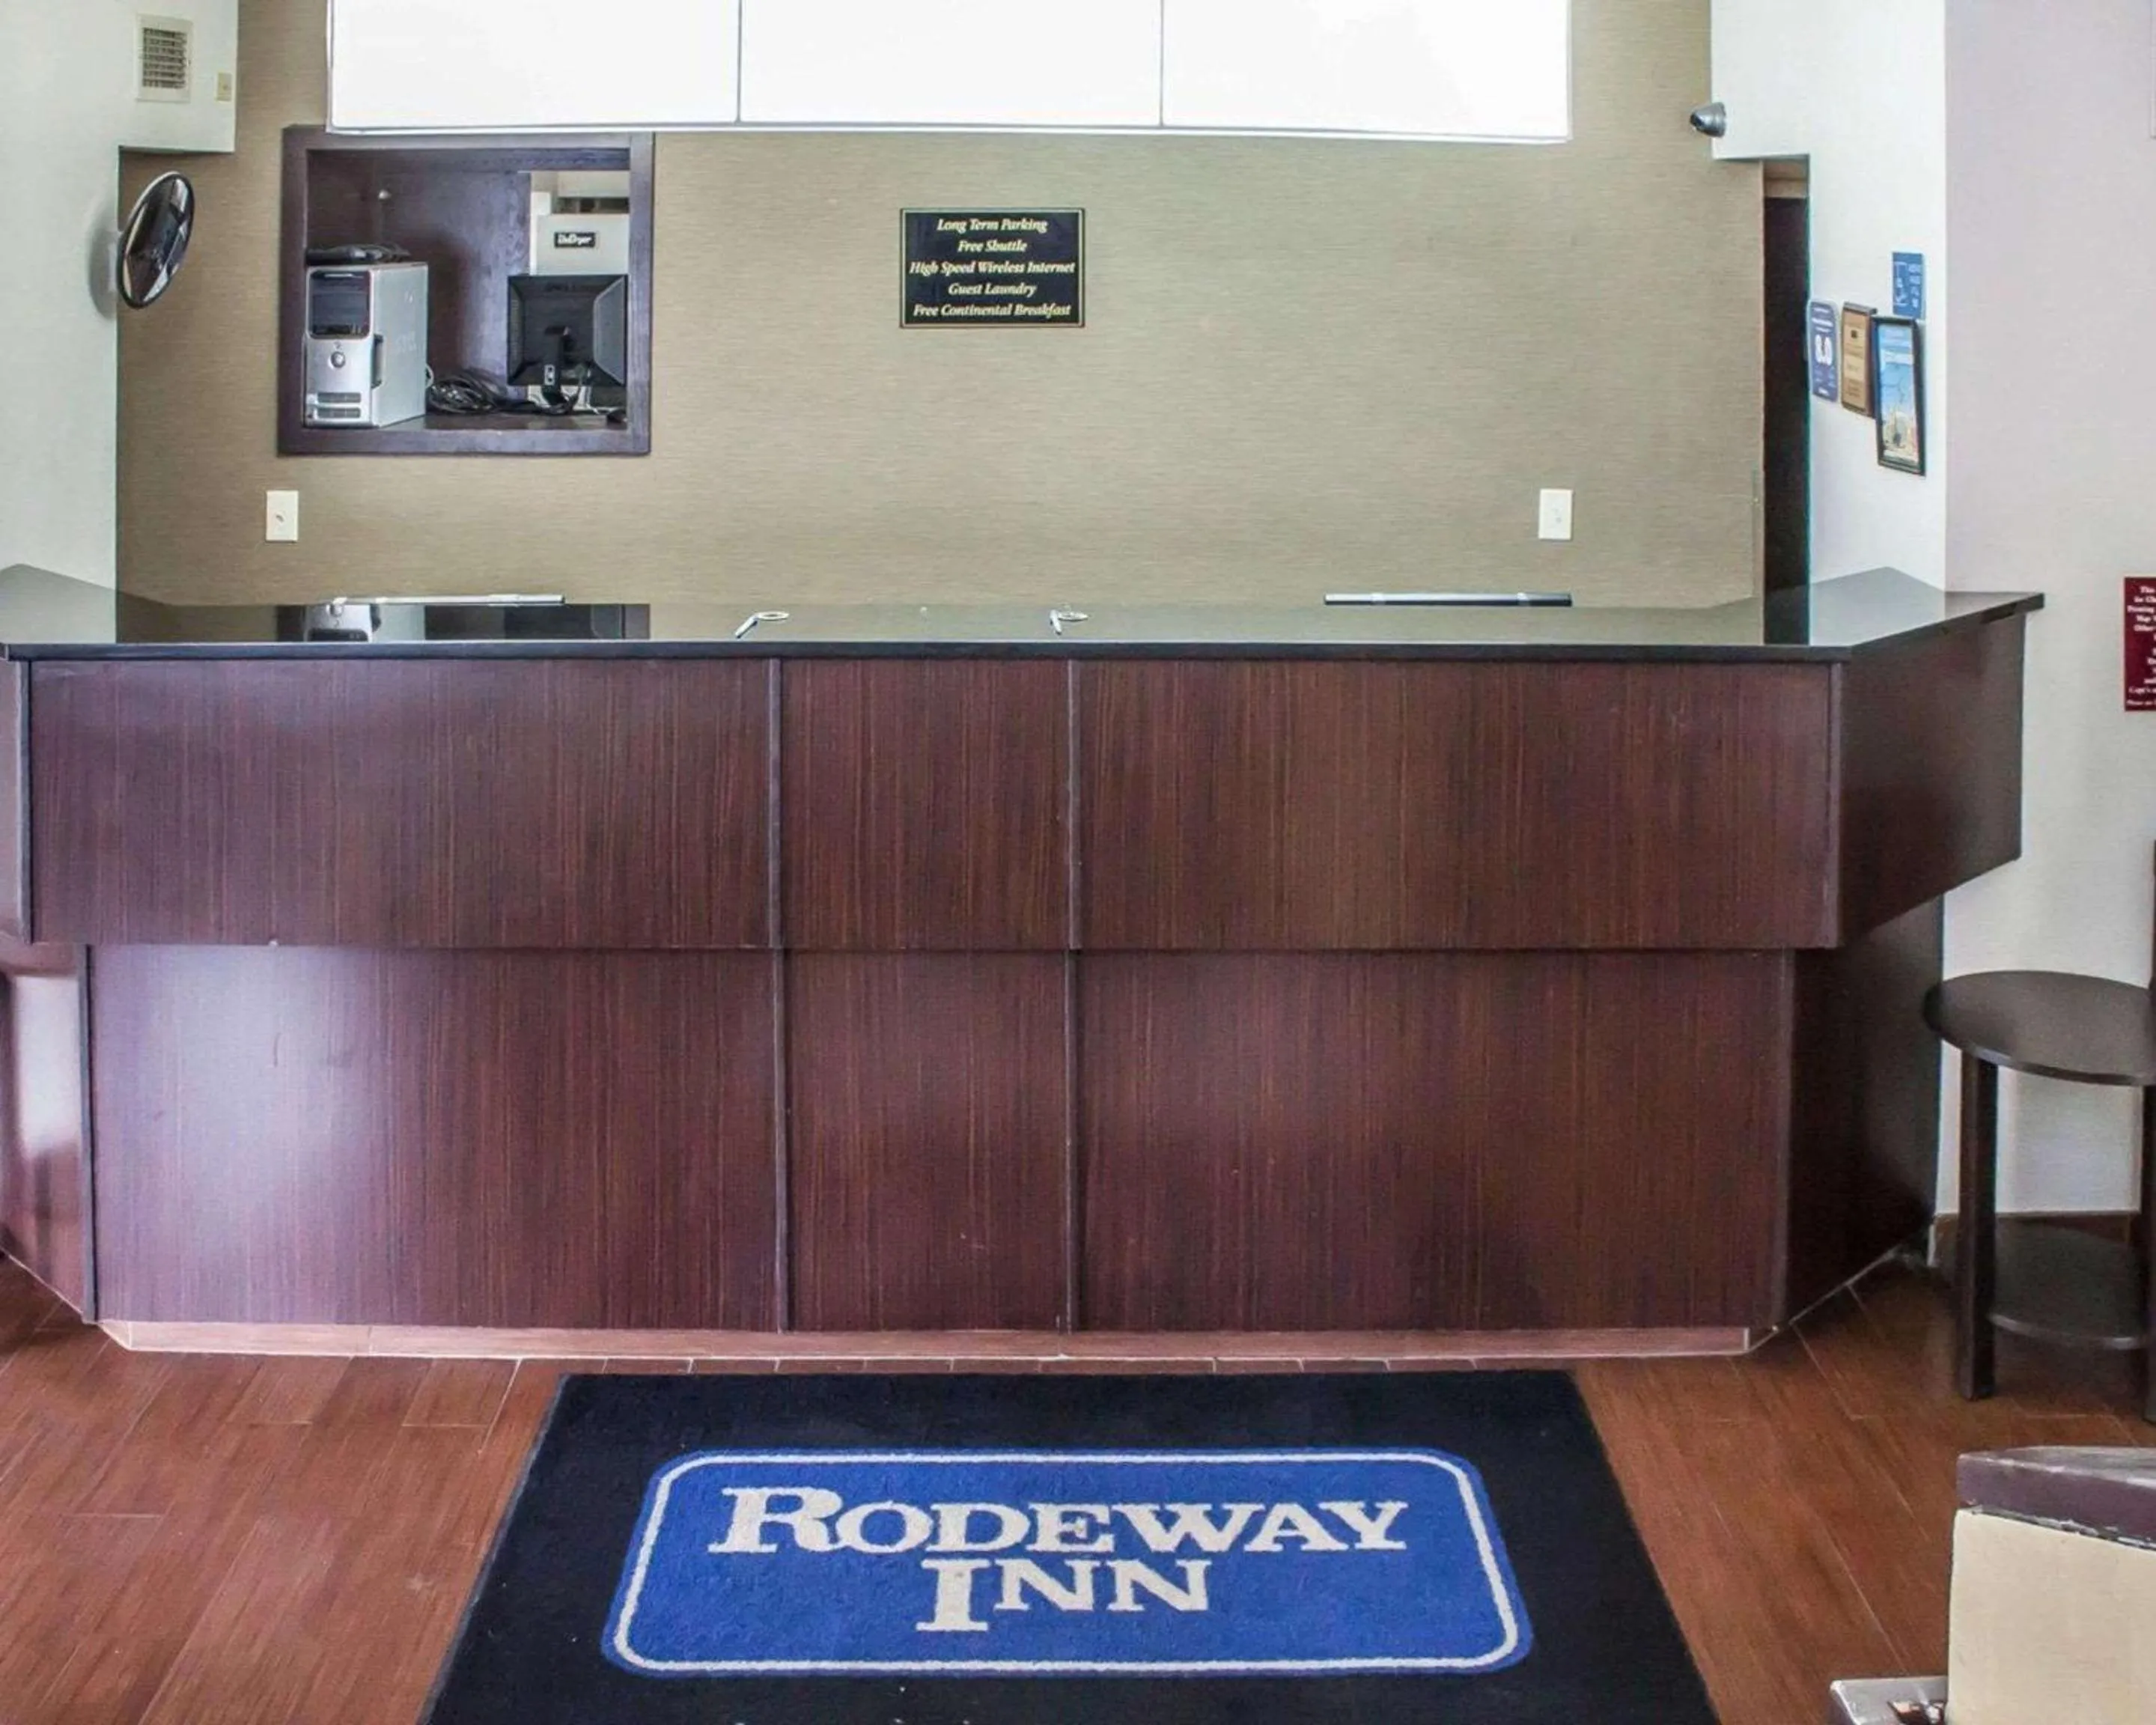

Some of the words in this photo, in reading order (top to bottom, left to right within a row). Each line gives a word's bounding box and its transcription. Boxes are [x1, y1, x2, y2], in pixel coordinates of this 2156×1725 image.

[937, 219, 967, 234] Long
[969, 219, 999, 231] Term
[1001, 219, 1049, 234] Parking
[957, 240, 984, 252] Free
[985, 240, 1028, 252] Shuttle
[909, 261, 939, 277] High
[940, 260, 976, 276] Speed
[978, 260, 1025, 273] Wireless
[1026, 261, 1076, 273] Internet
[948, 282, 983, 295] Guest
[984, 282, 1038, 298] Laundry
[913, 303, 939, 317] Free
[941, 302, 1013, 316] Continental
[1014, 302, 1071, 319] Breakfast
[707, 1487, 1409, 1553] RODEWAY
[916, 1559, 1212, 1631] INN
